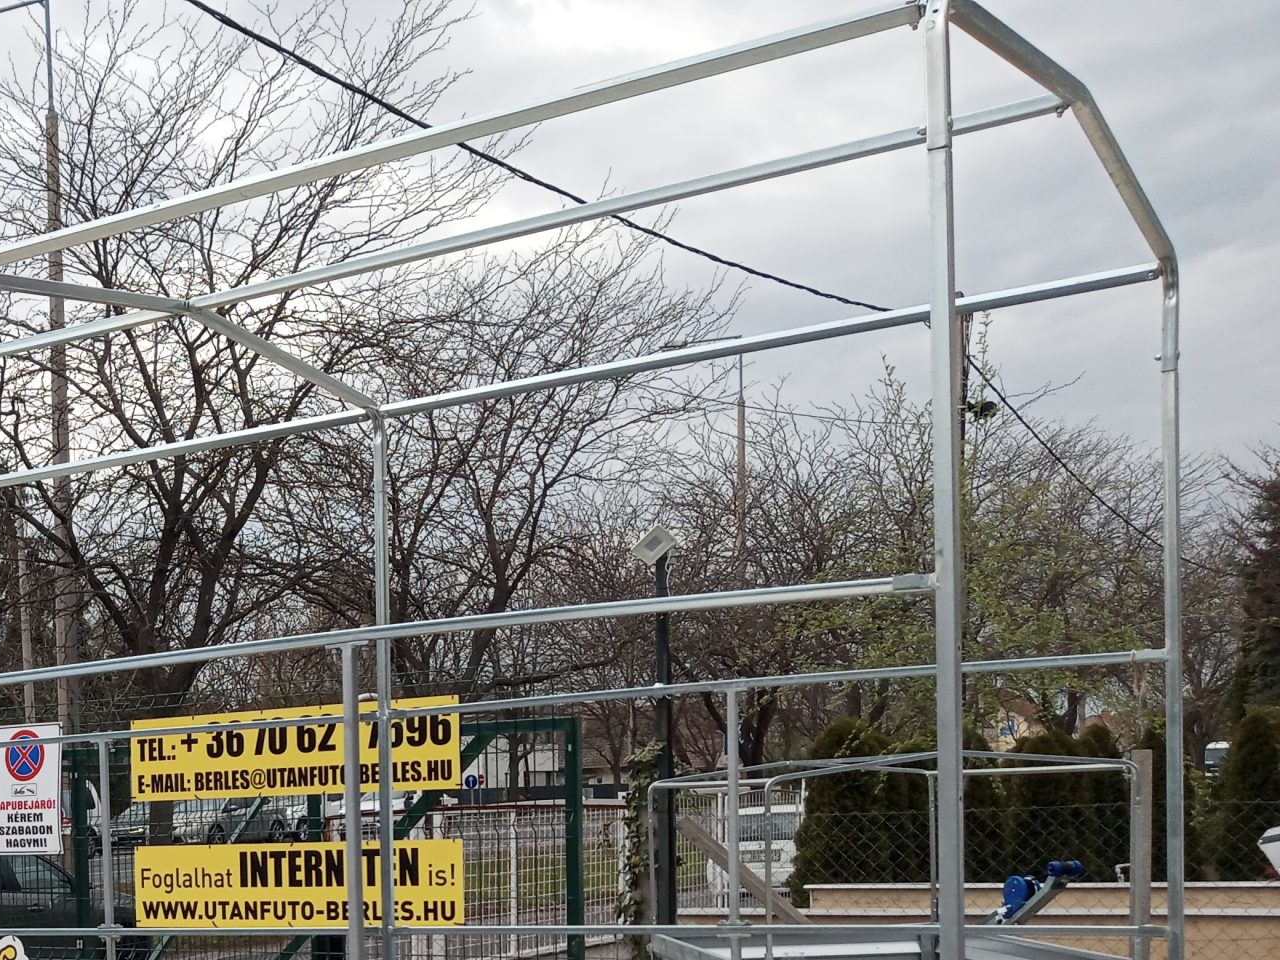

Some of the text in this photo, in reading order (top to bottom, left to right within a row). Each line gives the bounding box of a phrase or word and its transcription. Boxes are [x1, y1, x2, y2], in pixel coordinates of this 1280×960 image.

[137, 737, 177, 763] TEL.:
[297, 713, 337, 752] 62
[137, 758, 453, 795] E-MAIL: BERLES@UTANFUTBELES.HU
[7, 811, 43, 823] KÉREM
[5, 838, 48, 848] HAGYNI!
[141, 847, 455, 893] Foglalhat INTERNTN is!
[142, 900, 456, 922] WWW.UTANFUTO-BERLS.HU
